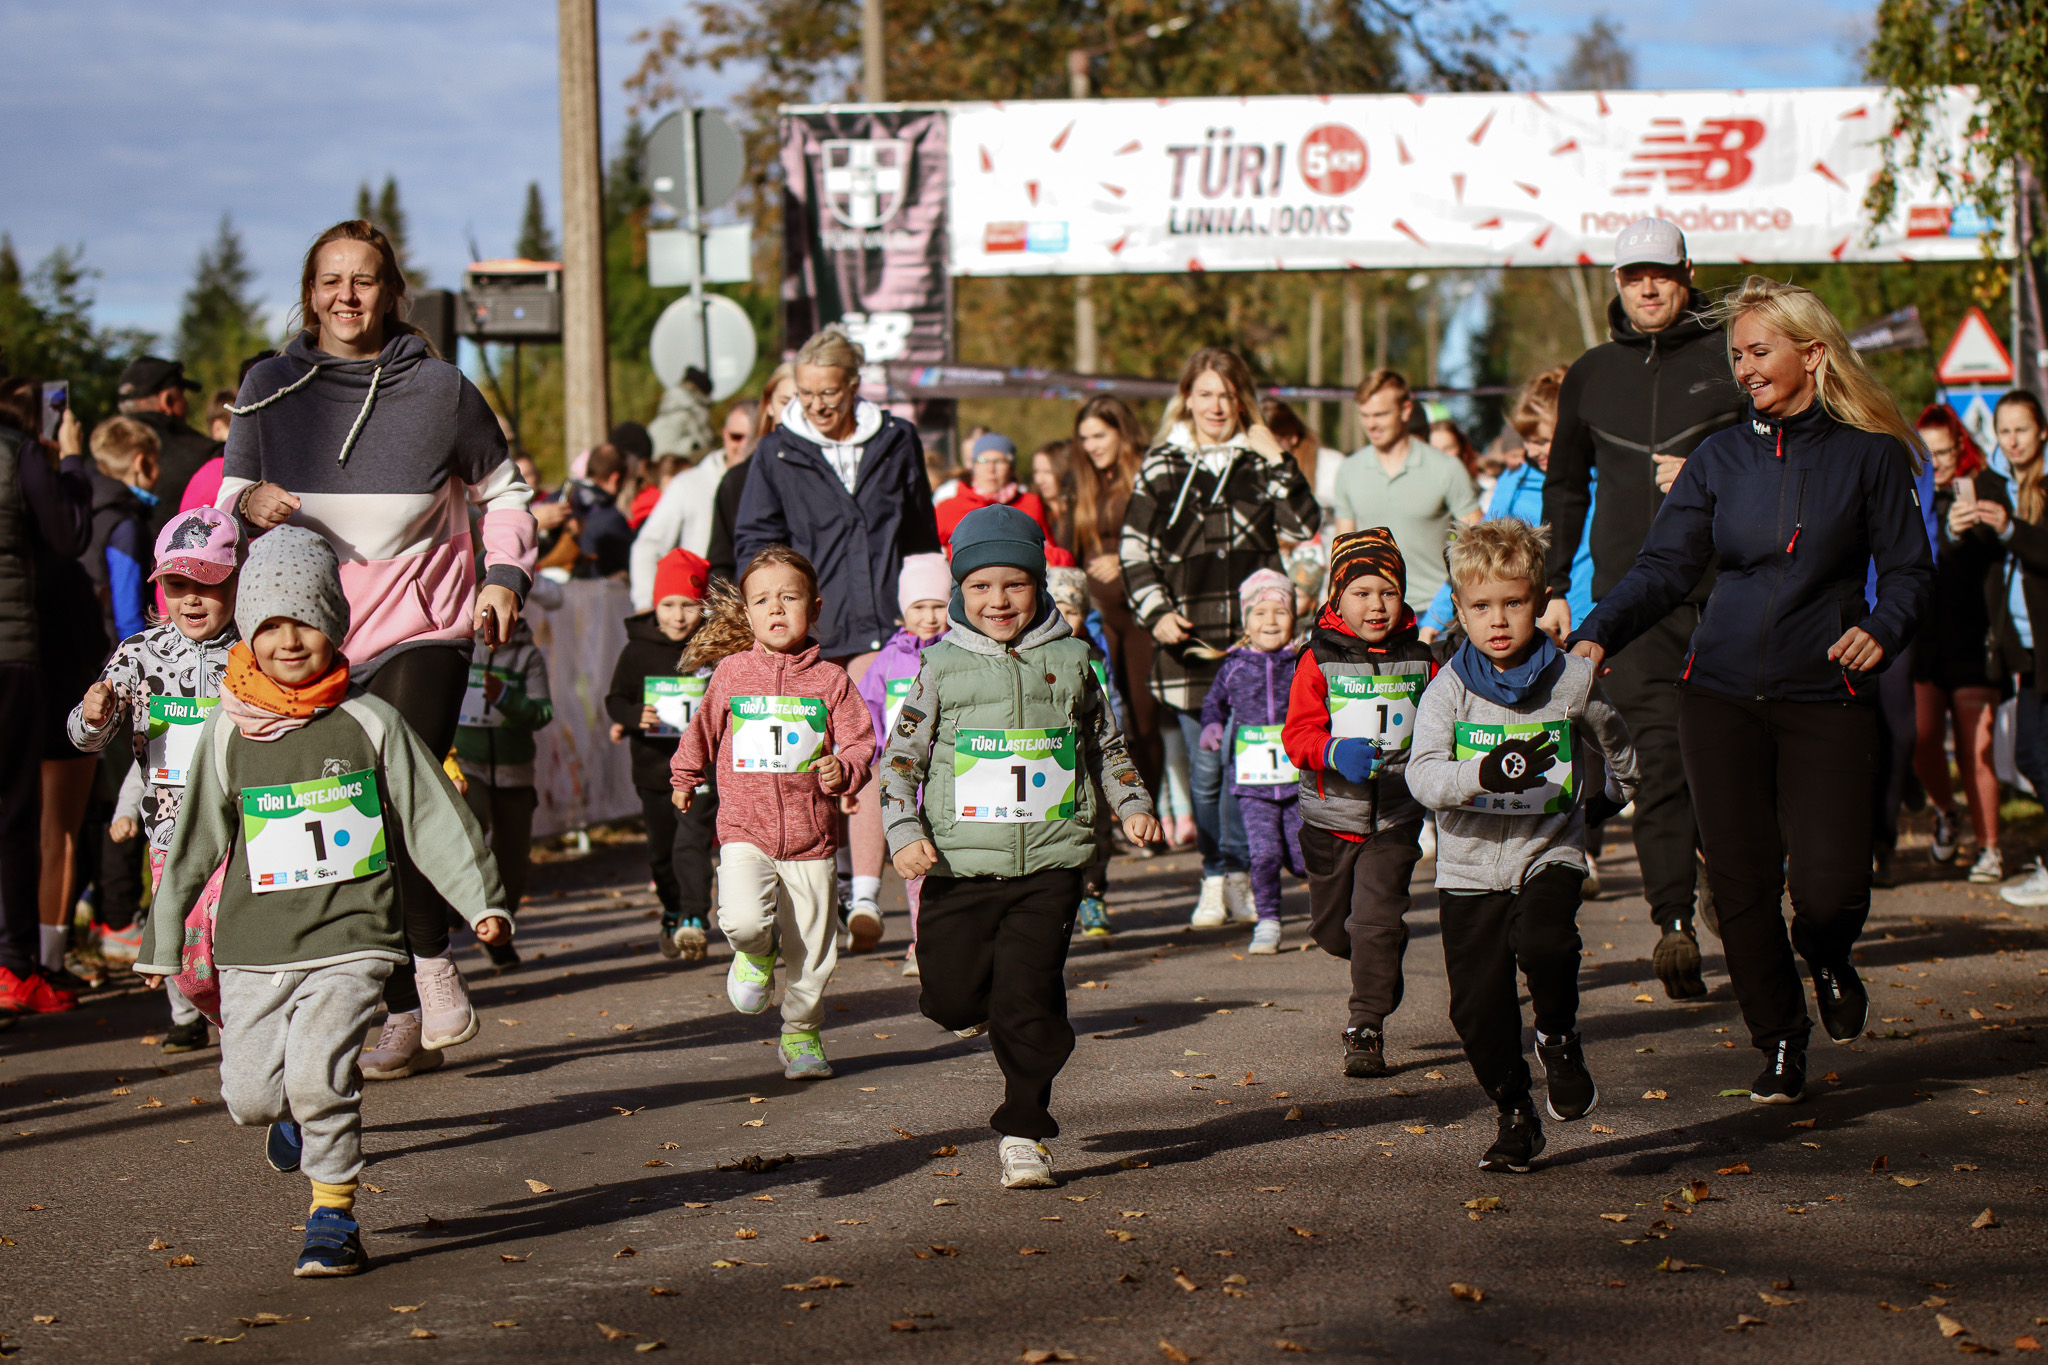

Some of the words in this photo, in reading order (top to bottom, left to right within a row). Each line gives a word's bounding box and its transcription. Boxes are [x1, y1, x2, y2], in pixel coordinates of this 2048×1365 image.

[1165, 126, 1287, 200] TÜRI
[1166, 203, 1355, 236] LINNAJOOKS
[1344, 680, 1365, 694] TÜRI
[1366, 681, 1416, 694] LASTEJOOKS
[163, 702, 188, 718] TÜRI
[682, 701, 691, 724] 1
[739, 700, 759, 714] TÜRI
[760, 703, 817, 717] LASTEJOOKS
[1376, 704, 1389, 734] 1
[769, 725, 783, 756] 1
[970, 735, 997, 752] TÜRI
[998, 736, 1063, 752] LASTEJOOKS
[1468, 729, 1495, 746] TÜRI
[1267, 748, 1279, 770] 1
[257, 793, 285, 813] TÜRI
[286, 781, 363, 810] LASTEJOOKS
[1010, 765, 1027, 803] 1
[305, 820, 328, 862] 1
